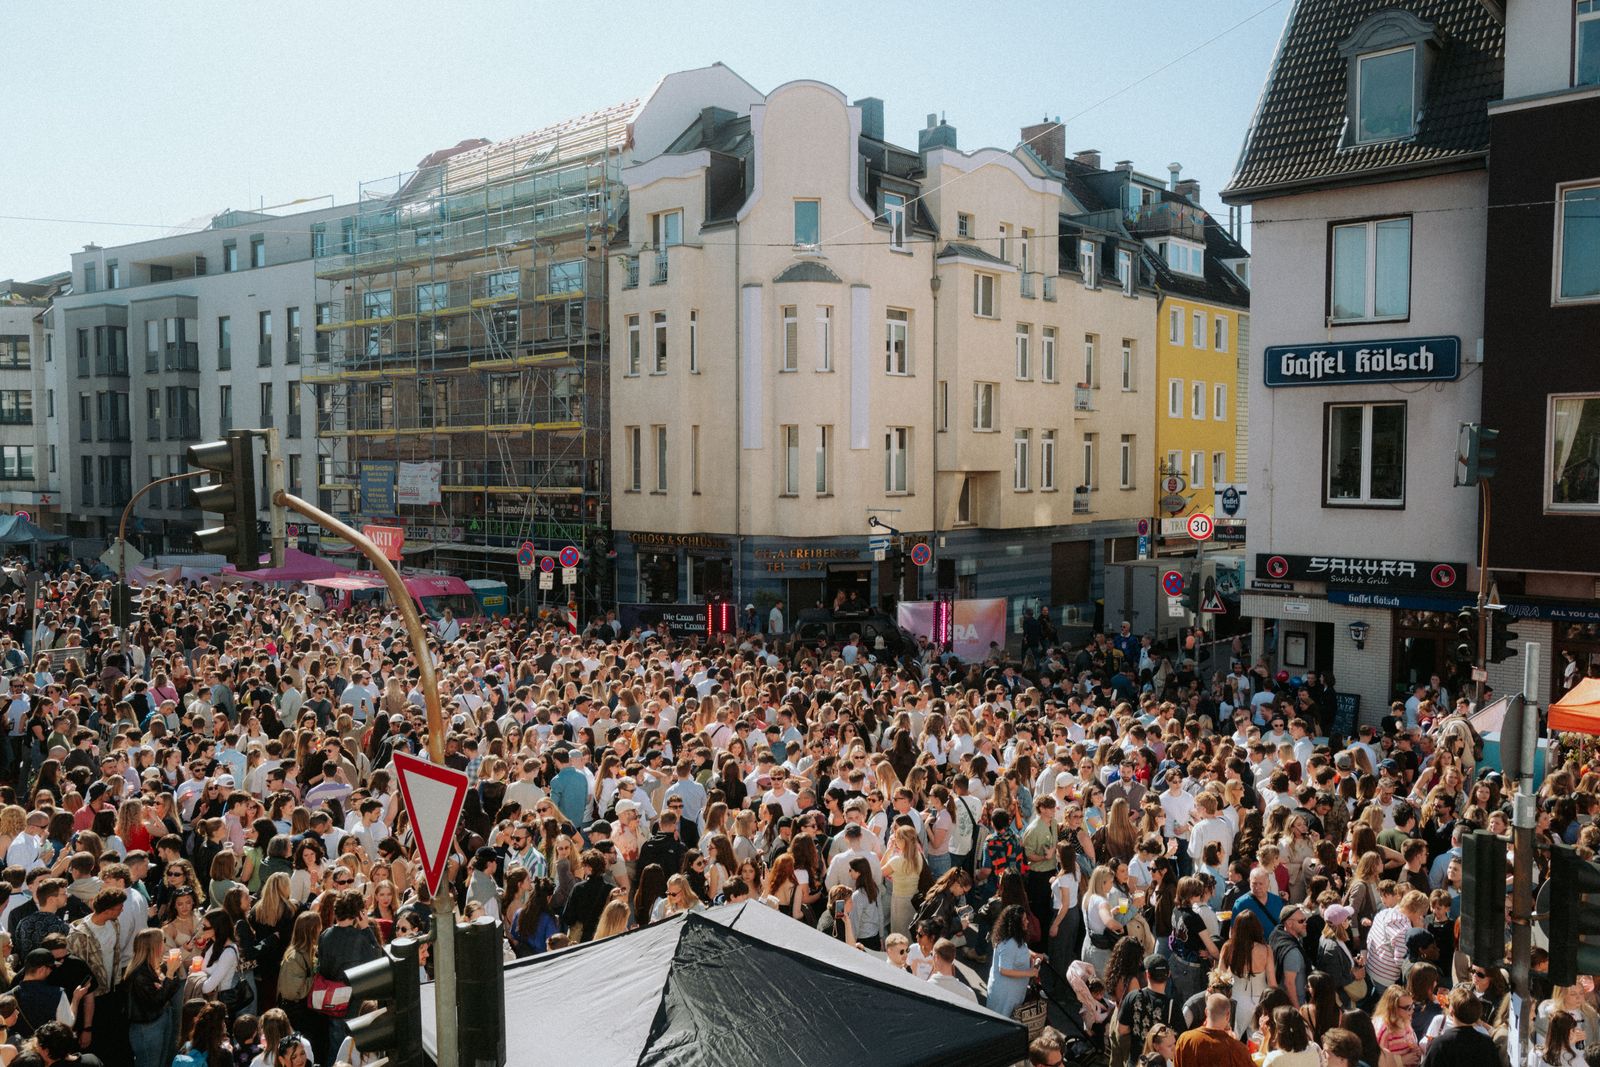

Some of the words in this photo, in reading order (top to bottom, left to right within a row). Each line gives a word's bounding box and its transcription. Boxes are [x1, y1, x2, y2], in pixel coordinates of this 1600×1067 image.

[1281, 350, 1346, 379] Gaffel
[1355, 345, 1434, 373] Kölsch
[1192, 520, 1208, 533] 30
[1306, 557, 1417, 578] SAKURA
[1330, 575, 1355, 583] Sushi
[1366, 577, 1389, 585] Grill
[1348, 593, 1372, 604] Gaffel
[1373, 594, 1400, 606] Kölsch
[663, 613, 675, 621] Die
[1504, 604, 1540, 617] URA
[1550, 609, 1566, 617] ALL
[1568, 610, 1586, 618] YOU
